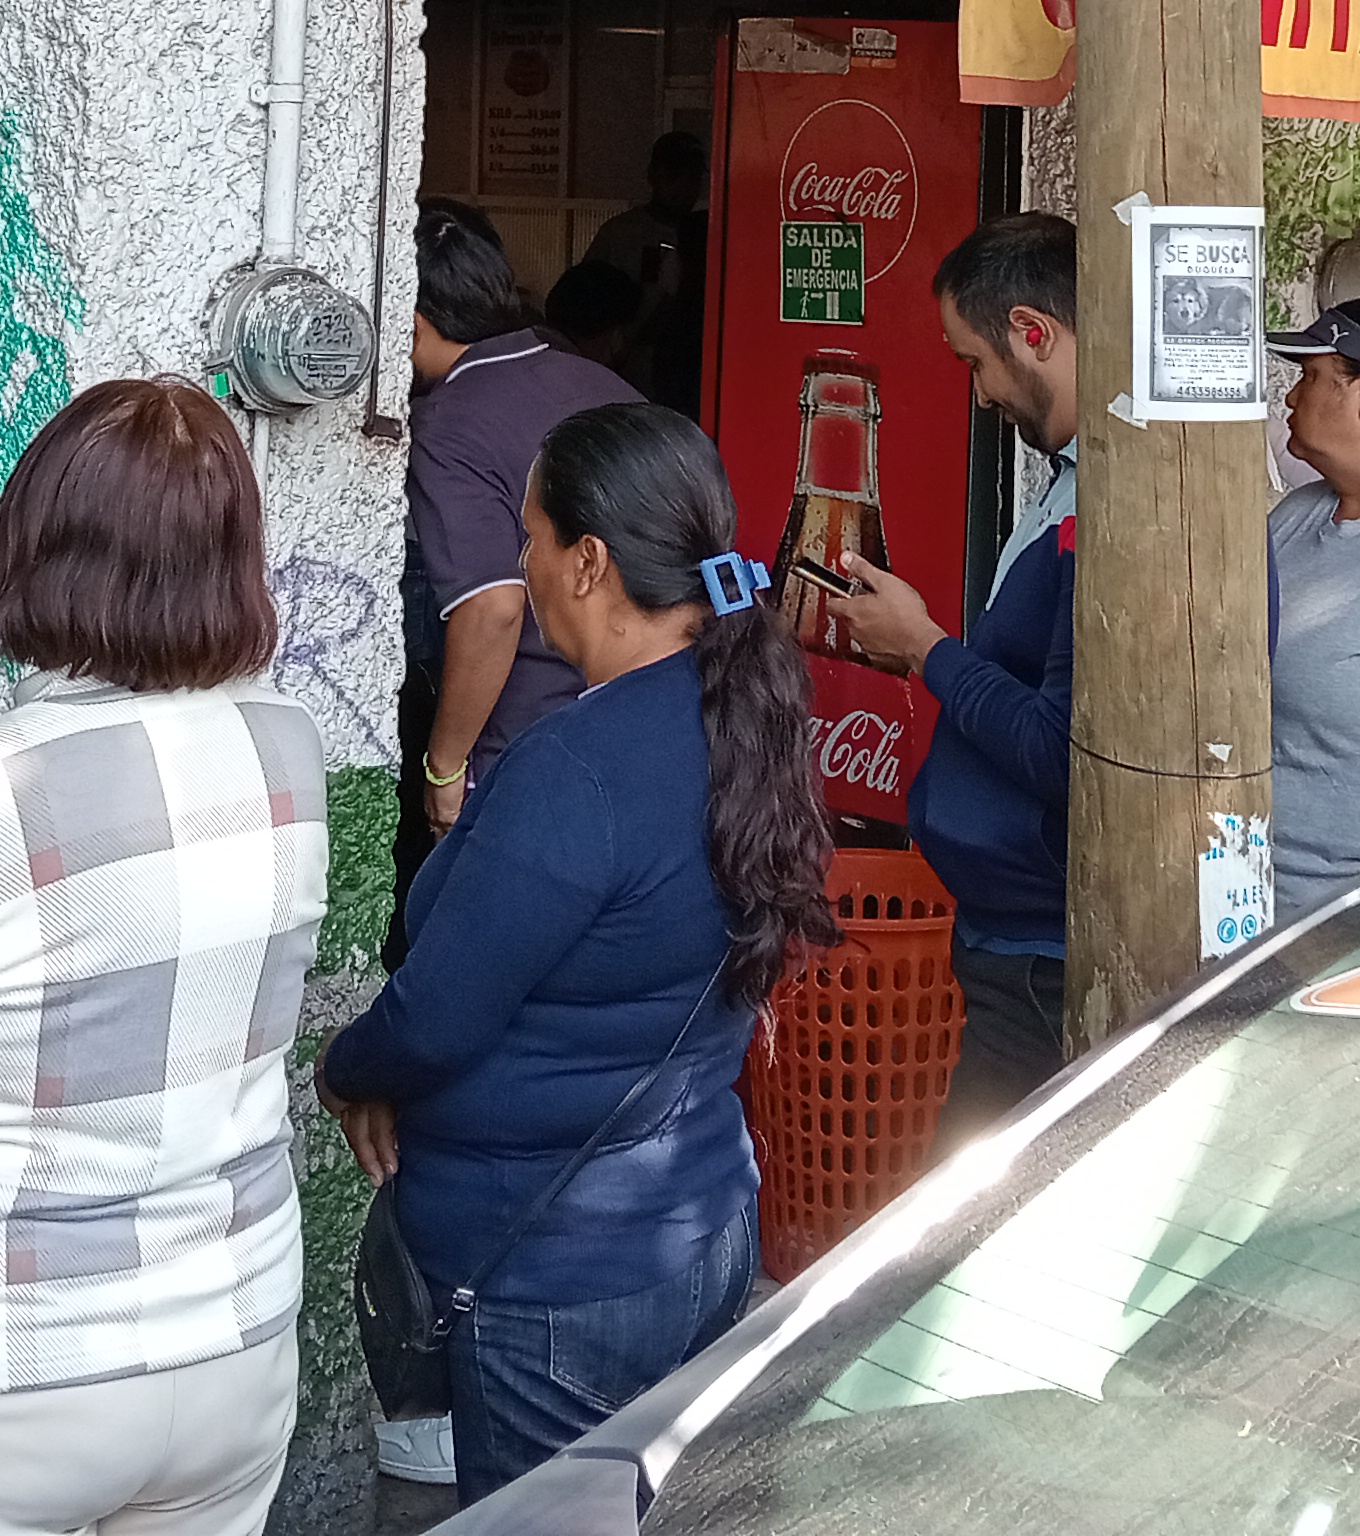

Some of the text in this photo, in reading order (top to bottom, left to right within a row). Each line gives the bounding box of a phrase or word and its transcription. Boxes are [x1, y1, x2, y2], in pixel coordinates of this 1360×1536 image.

[789, 162, 909, 220] Coca-Cola
[786, 227, 858, 248] SALIDA
[811, 249, 832, 267] DE
[1165, 244, 1251, 264] SE BUSCA
[786, 269, 858, 290] EMERGENCIA
